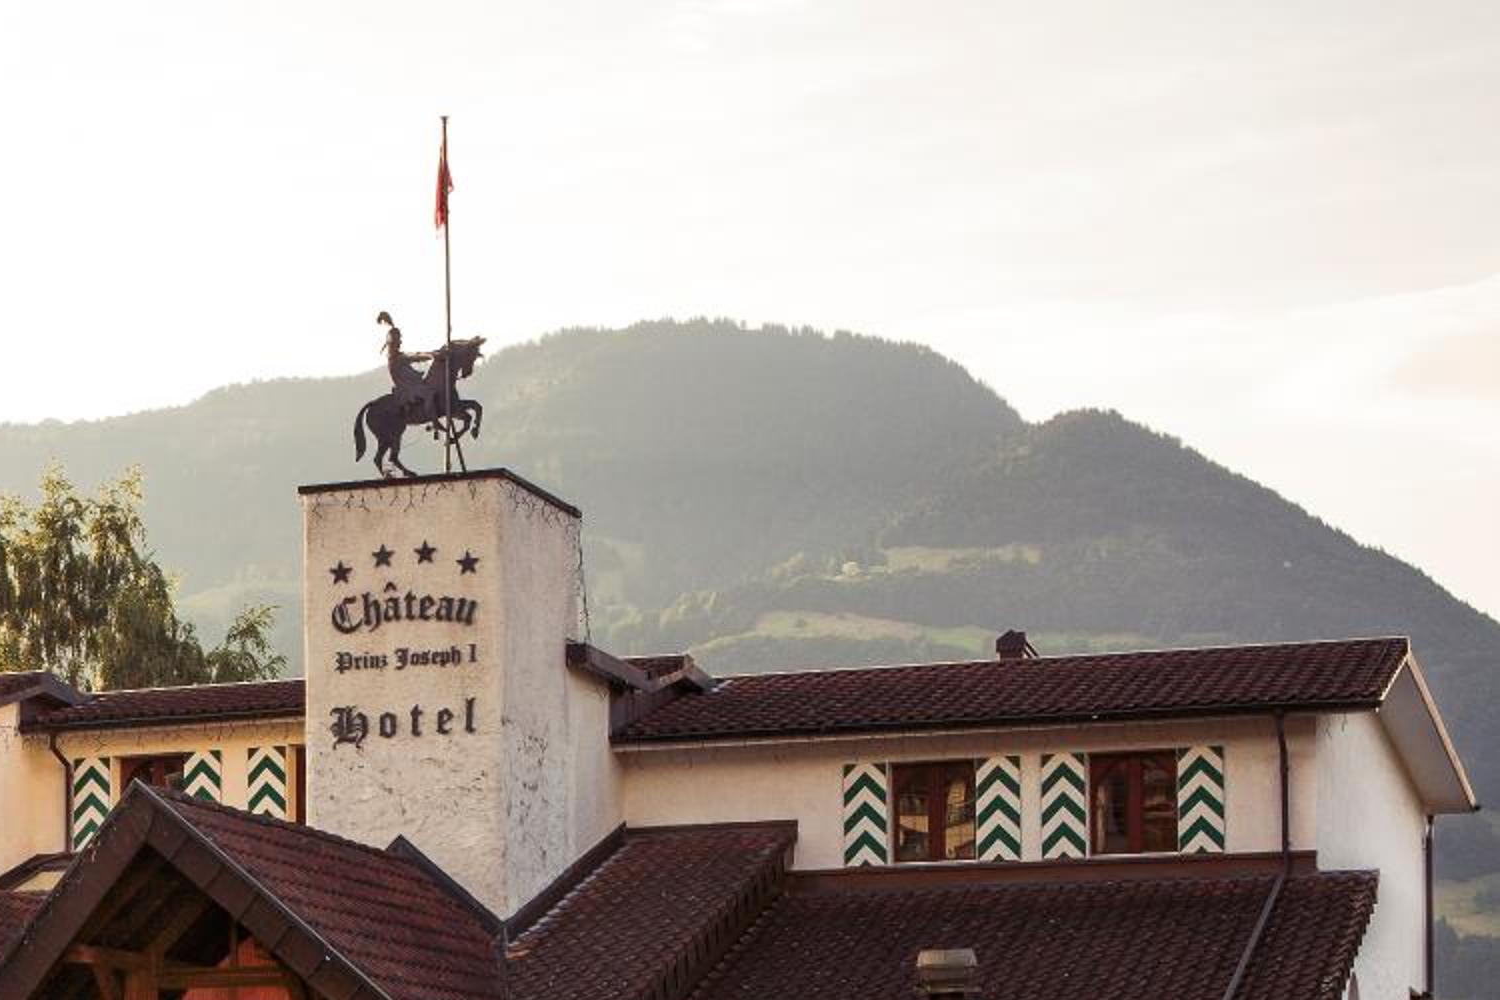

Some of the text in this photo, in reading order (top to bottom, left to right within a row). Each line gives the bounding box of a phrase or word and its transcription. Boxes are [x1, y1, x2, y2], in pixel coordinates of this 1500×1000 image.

[331, 581, 477, 635] Château
[334, 651, 389, 674] Prinz
[394, 645, 461, 671] Joseph
[329, 697, 477, 752] Hotel
